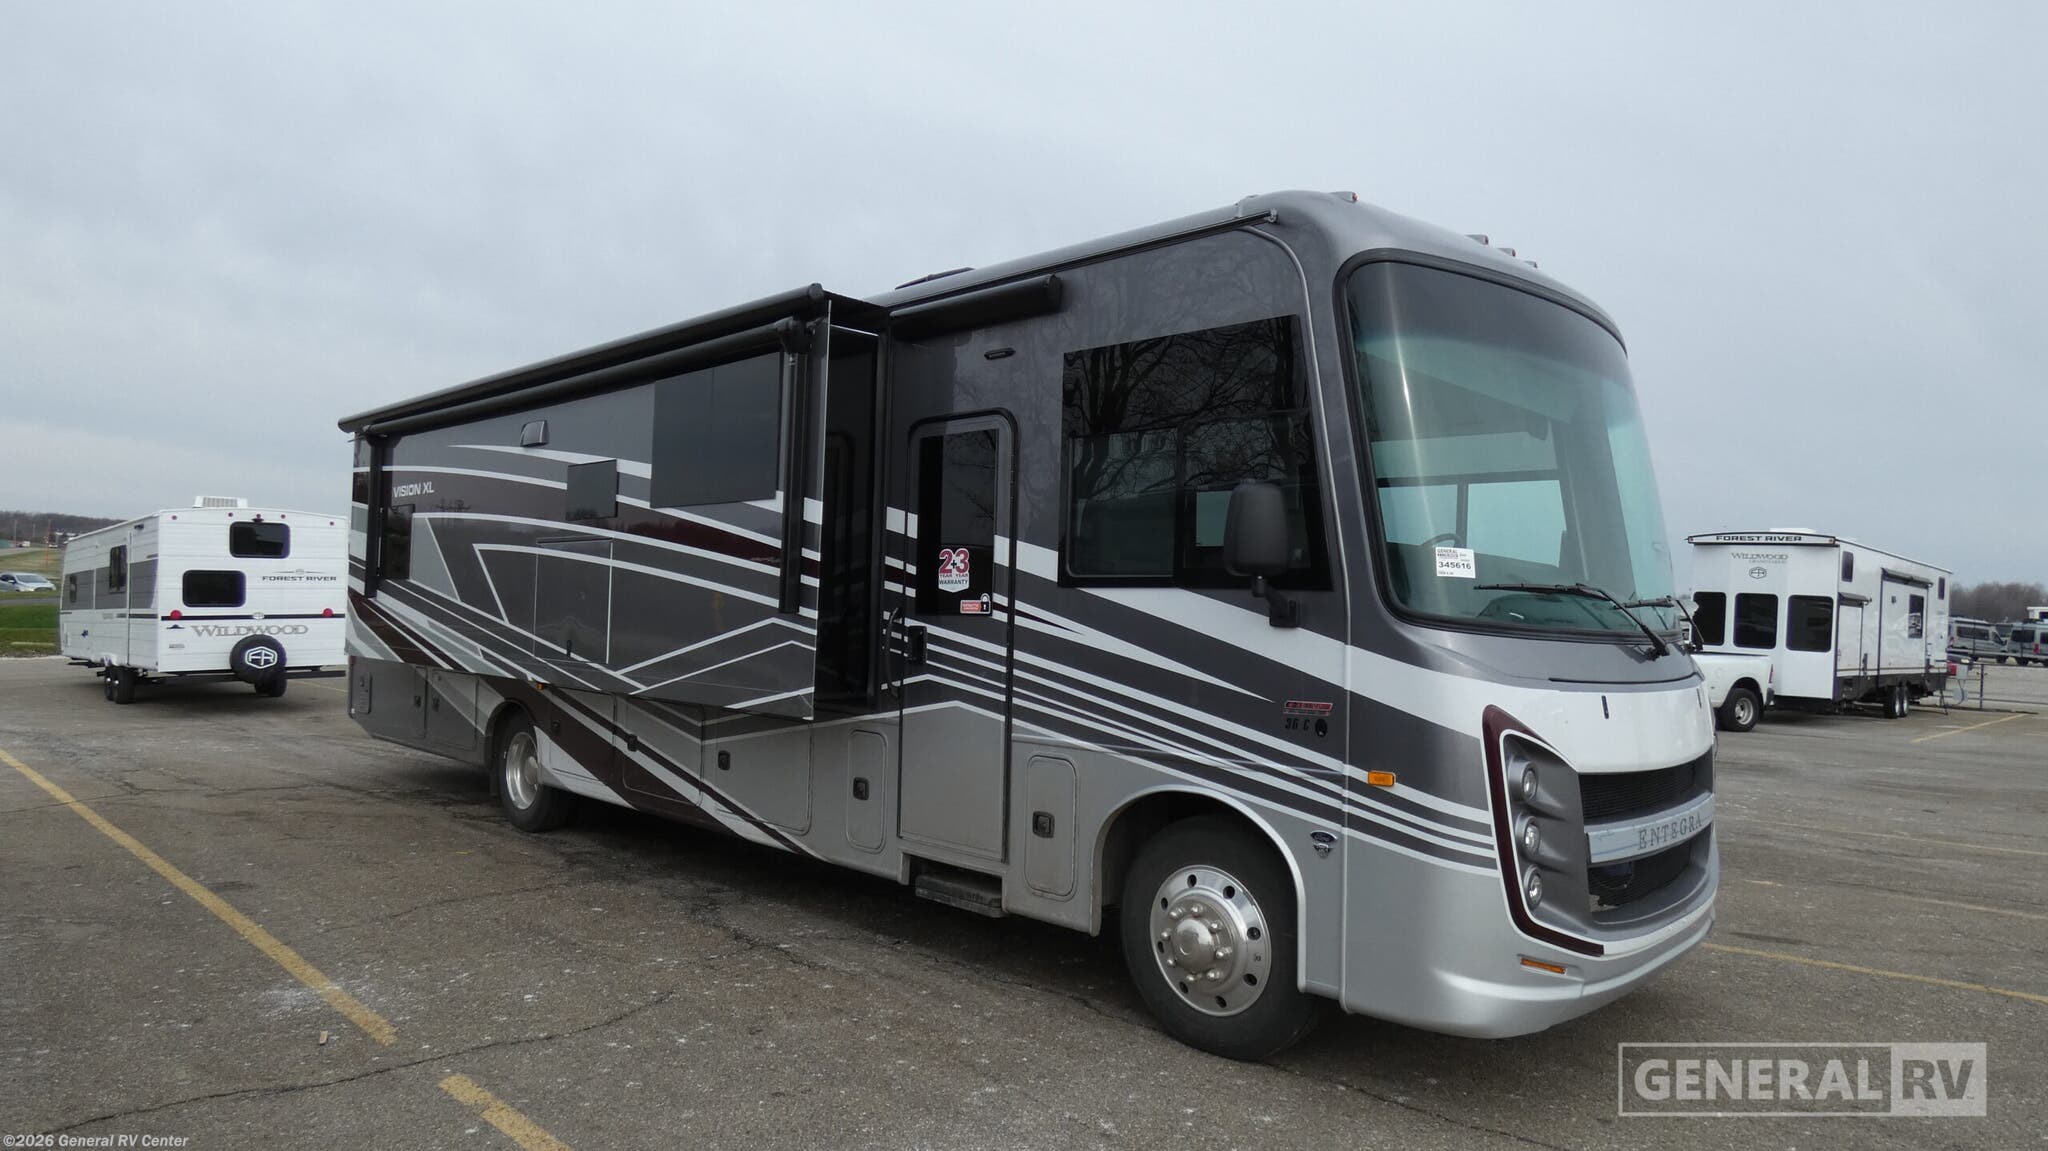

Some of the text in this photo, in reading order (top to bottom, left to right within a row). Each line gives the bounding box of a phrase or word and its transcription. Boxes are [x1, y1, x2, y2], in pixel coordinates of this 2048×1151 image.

[393, 481, 434, 498] VISION XL
[1731, 552, 1788, 560] WILDWOOD
[1438, 561, 1471, 569] 345616
[191, 624, 309, 637] WILDWOOD
[1638, 813, 1702, 850] ENTEGRA
